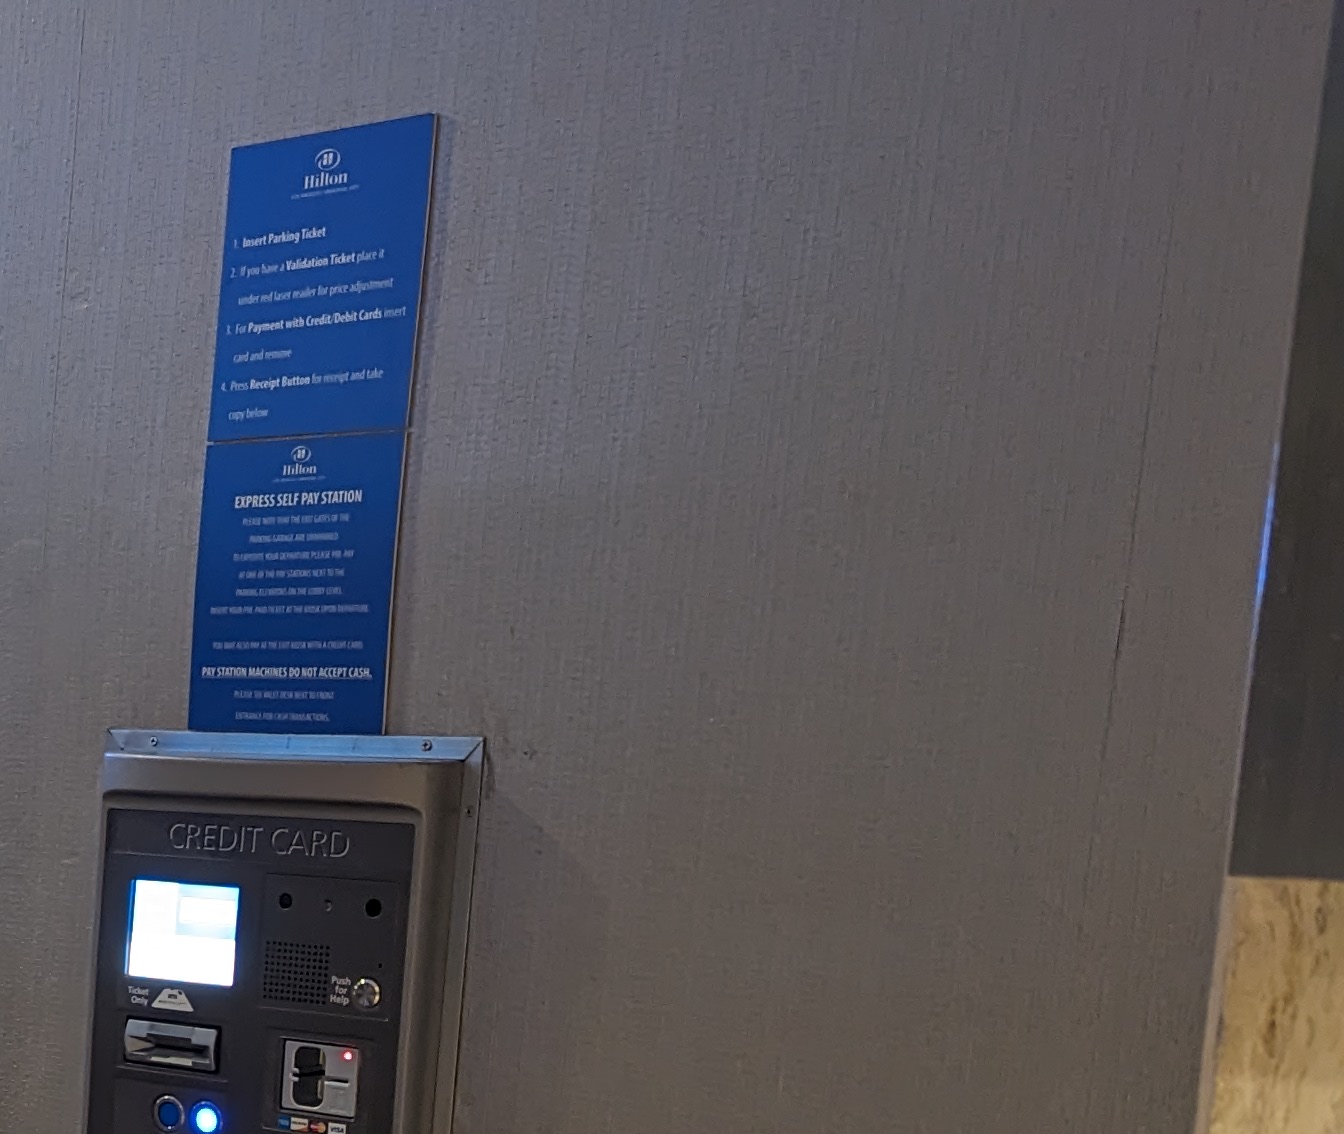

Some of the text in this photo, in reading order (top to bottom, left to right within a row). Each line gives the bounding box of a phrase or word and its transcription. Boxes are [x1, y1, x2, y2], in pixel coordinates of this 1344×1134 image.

[303, 171, 349, 190] Hilton
[242, 235, 267, 249] Insert
[268, 230, 300, 244] Parking
[301, 227, 326, 240] Ticket
[286, 257, 329, 271] Validation
[330, 253, 355, 265] Ticket
[247, 320, 285, 335] Payment
[285, 317, 305, 329] with
[358, 307, 382, 321] Cards
[249, 377, 281, 391] Receipt
[281, 375, 311, 388] Button
[282, 463, 318, 476] Hilton
[234, 489, 363, 509] EXPRESS SELF PAY STATION
[201, 667, 216, 677] PAY
[217, 667, 247, 677] STATION
[248, 667, 288, 677] MACHINES
[288, 667, 300, 677] DO
[301, 667, 318, 677] NOT
[318, 667, 348, 678] ACCEPT
[170, 823, 350, 857] CREDIT CARD
[331, 976, 351, 986] Push
[127, 985, 150, 996] Ticket
[335, 985, 348, 994] for
[131, 995, 148, 1007] Only
[330, 994, 350, 1006] Help
